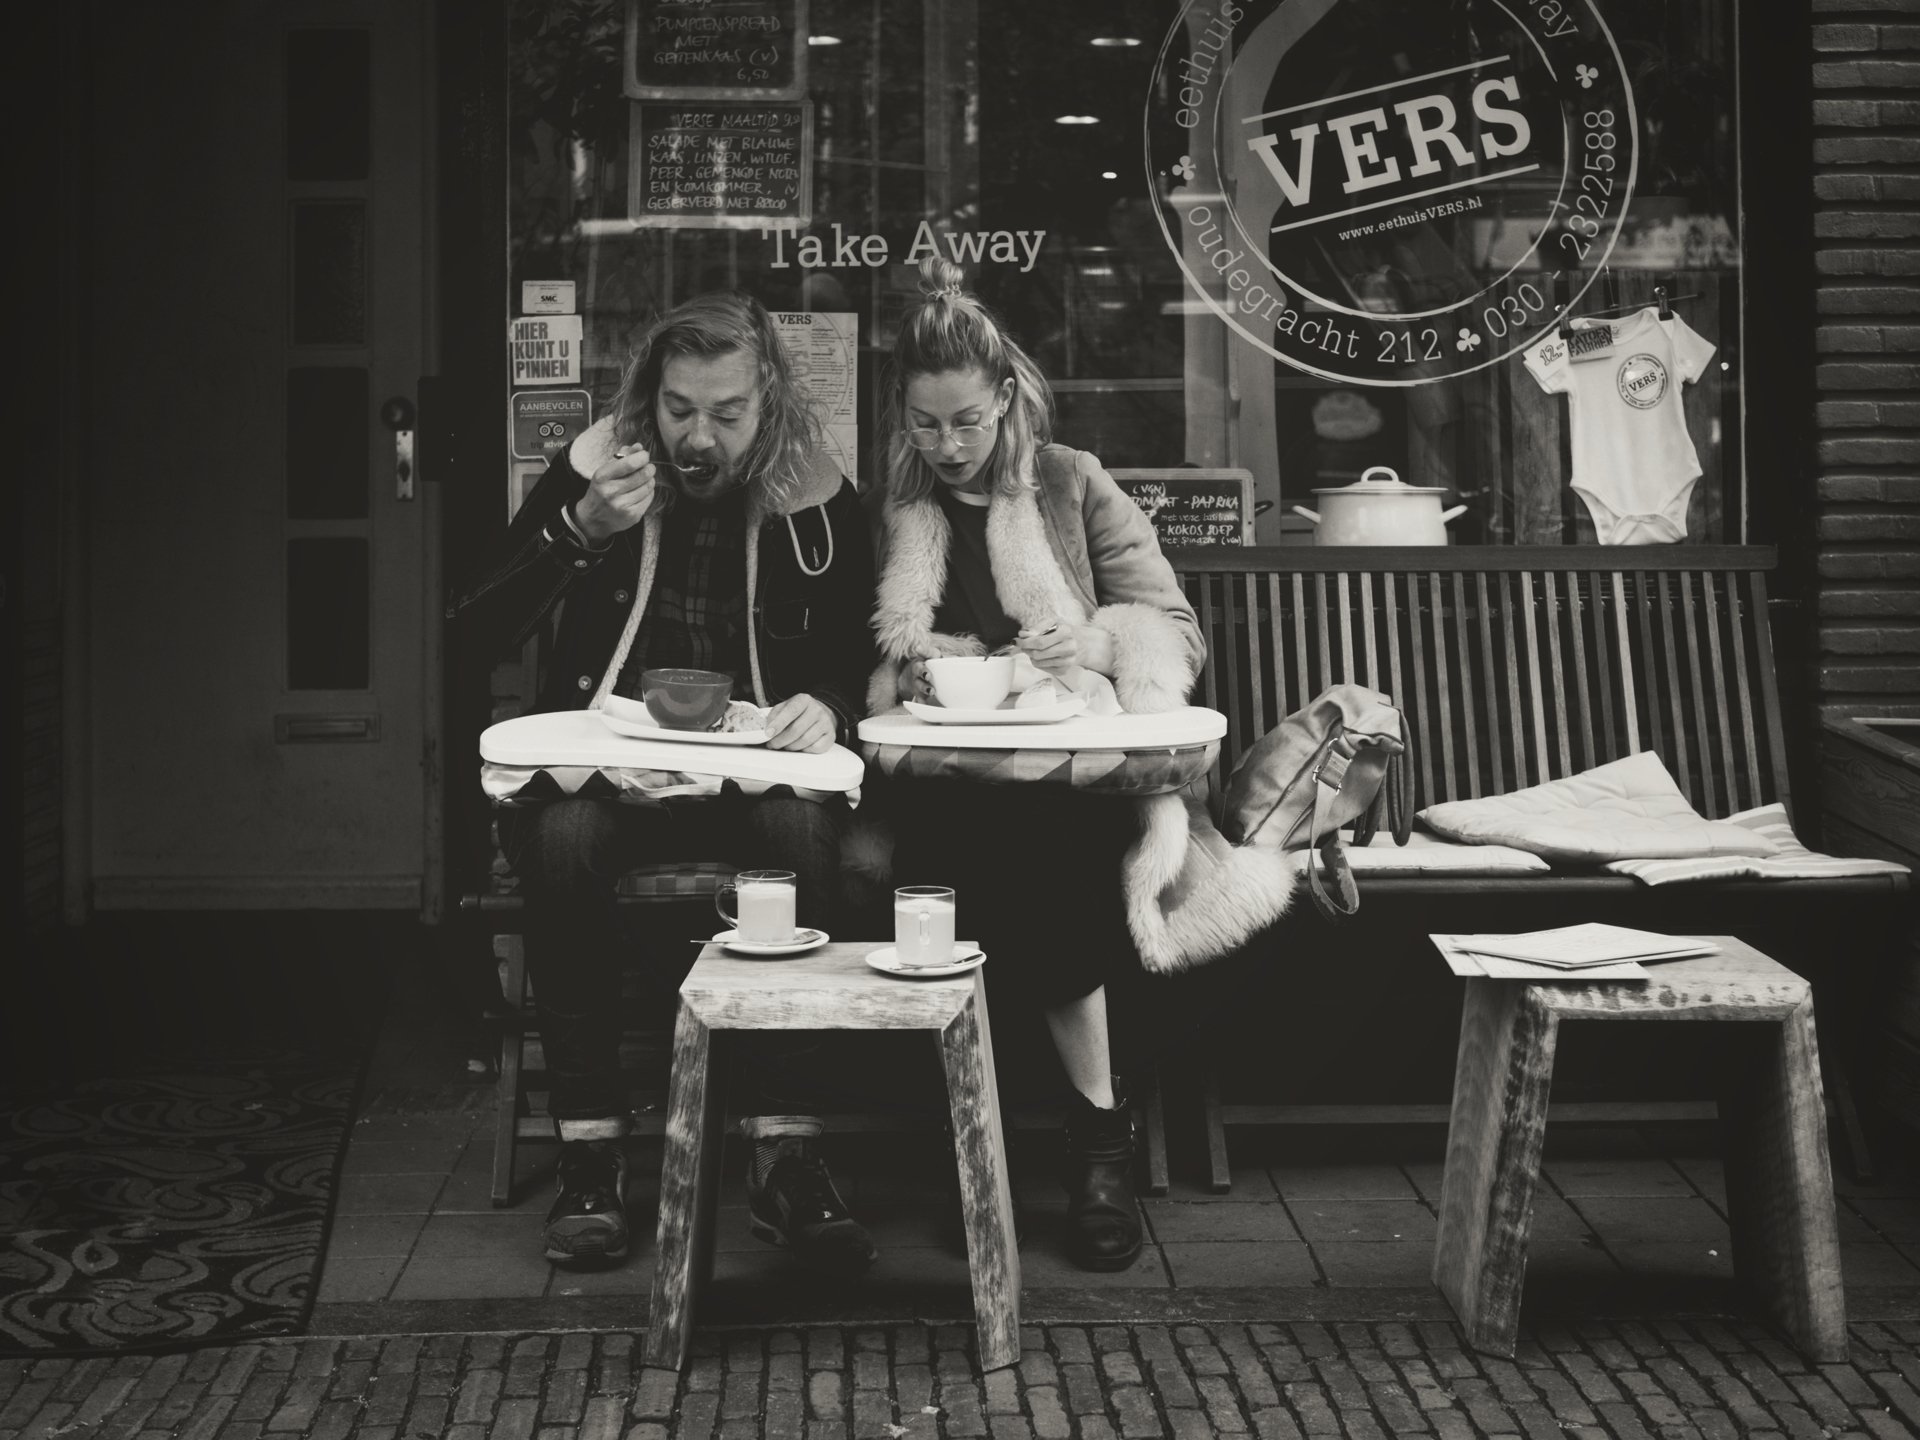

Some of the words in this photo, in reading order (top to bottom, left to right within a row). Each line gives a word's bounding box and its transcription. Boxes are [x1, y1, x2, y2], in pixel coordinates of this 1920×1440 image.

[1529, 0, 1579, 38] ay
[674, 35, 719, 50] MET
[1176, 1, 1244, 128] eethuis
[676, 113, 715, 127] VERSE
[648, 135, 700, 149] SALADE
[707, 136, 738, 150] MET
[742, 137, 796, 150] BLAUWE
[1247, 75, 1532, 208] VERS
[650, 181, 670, 193] EN
[727, 198, 753, 209] MET
[1188, 206, 1361, 359] oudegracht
[1376, 328, 1443, 363] 212
[1483, 283, 1545, 338] 030
[1559, 109, 1617, 261] 2322588
[762, 223, 889, 269] Take
[904, 220, 1046, 273] Away
[540, 295, 558, 303] SMC
[778, 314, 812, 325] VERS
[514, 322, 548, 341] HIER
[514, 341, 555, 360] KUNT
[559, 340, 569, 358] U
[516, 359, 570, 379] PINNEN
[1628, 371, 1658, 392] VERS
[520, 401, 583, 411] AANBEVOLEN
[1167, 524, 1204, 536] KOKOS
